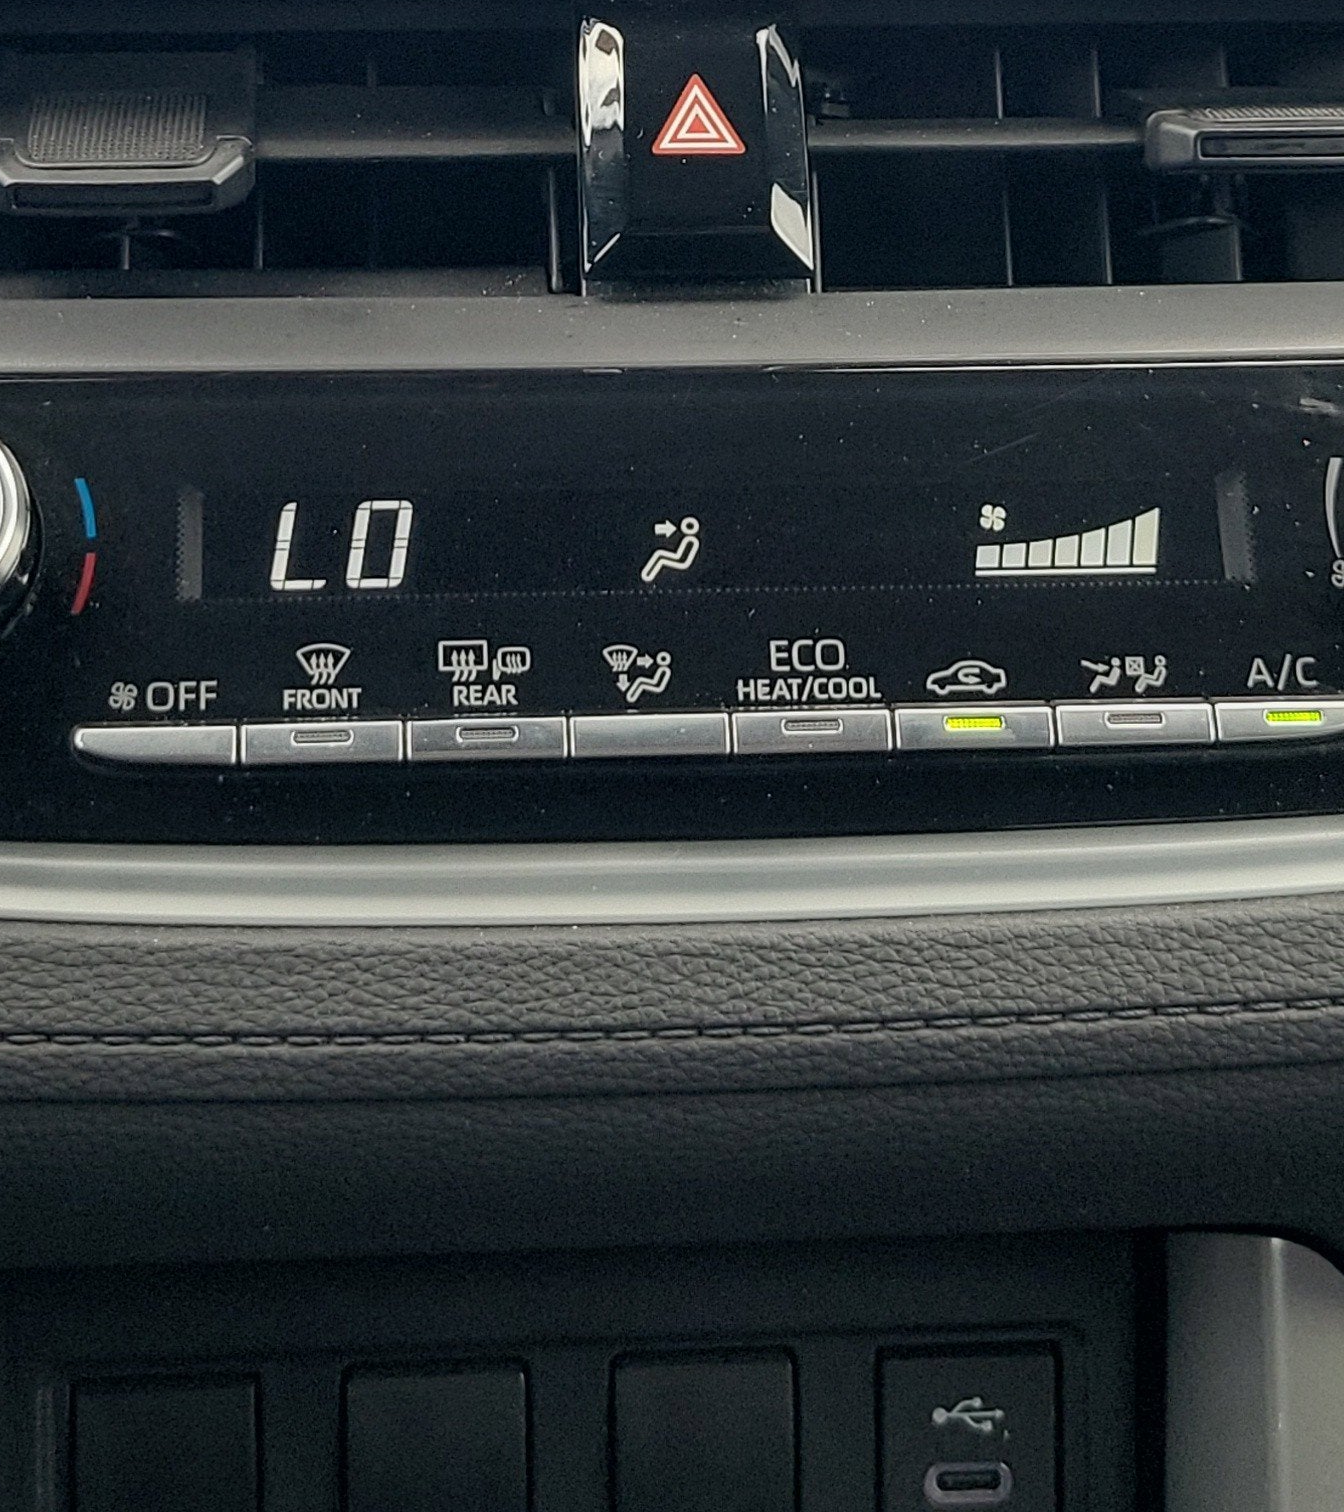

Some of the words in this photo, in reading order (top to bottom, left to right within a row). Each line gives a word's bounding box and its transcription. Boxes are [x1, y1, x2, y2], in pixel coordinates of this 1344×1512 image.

[769, 638, 846, 672] ECO
[1247, 653, 1319, 691] A/C
[146, 679, 218, 713] OFF
[282, 687, 362, 711] FRONT
[452, 684, 519, 707] REAR
[736, 675, 882, 702] HEAT/COOL
